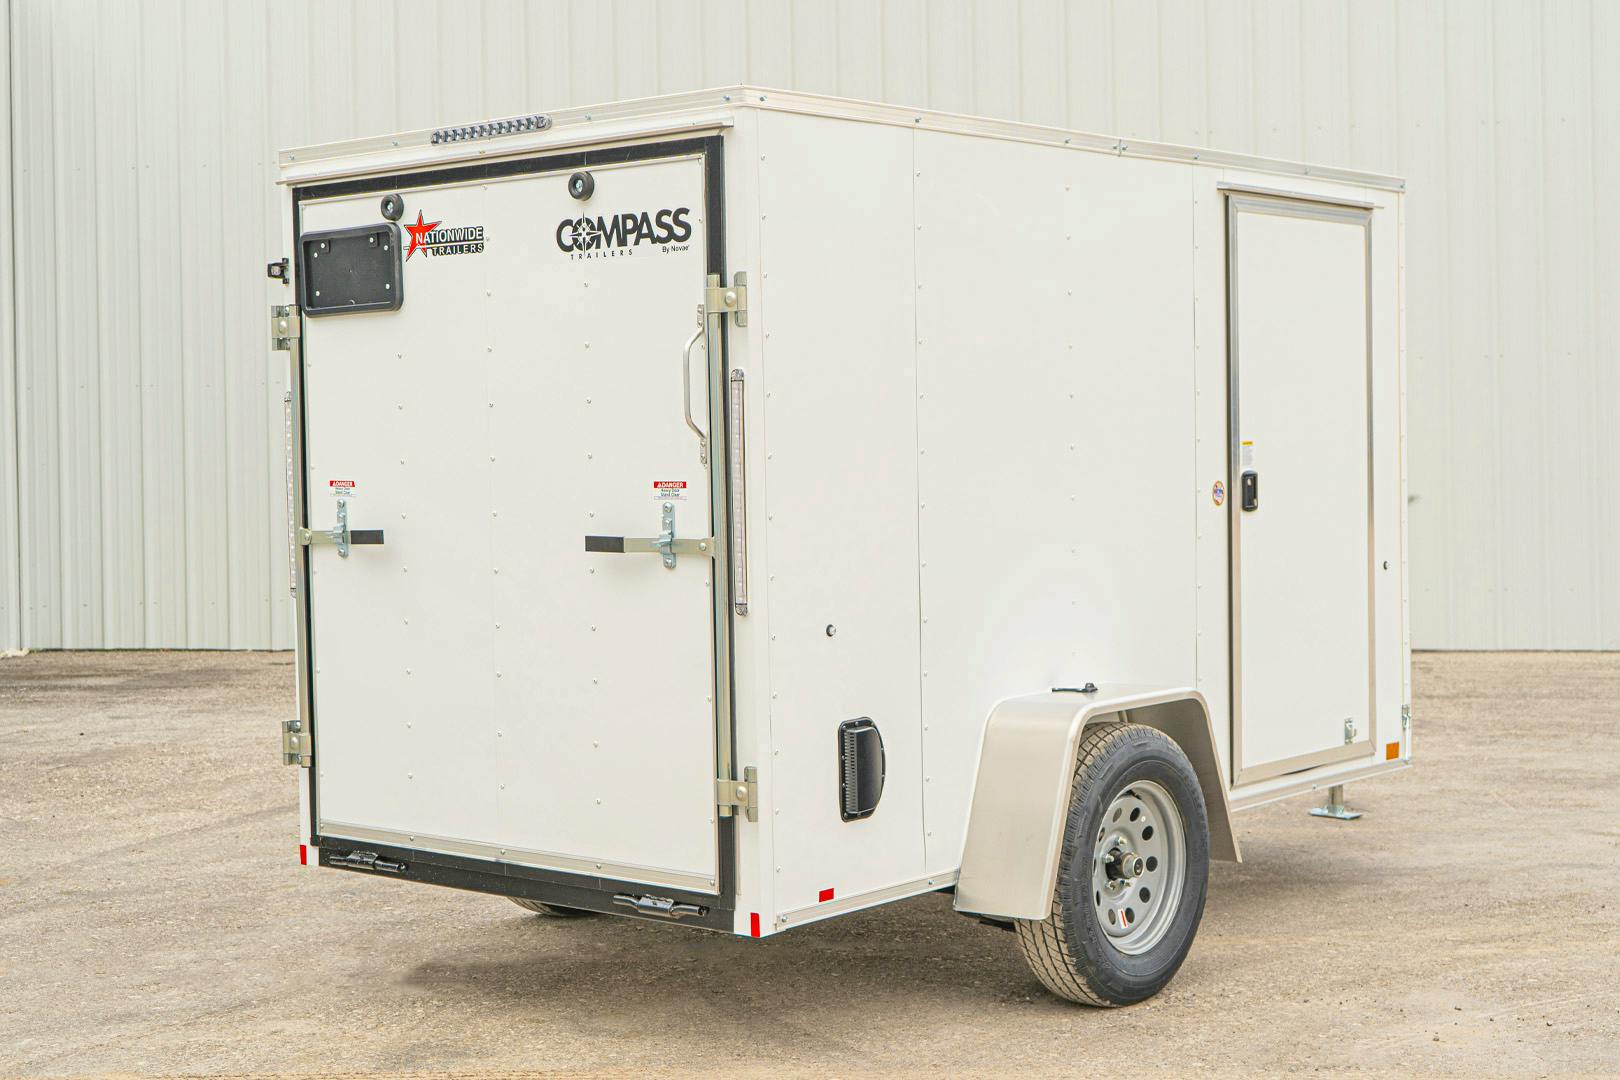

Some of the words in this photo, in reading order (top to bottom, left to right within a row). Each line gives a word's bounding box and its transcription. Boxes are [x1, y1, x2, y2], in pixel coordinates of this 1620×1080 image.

[415, 226, 484, 244] NATIONWIDE
[556, 207, 692, 252] COMPASS
[432, 244, 483, 256] TRAILERS
[571, 249, 633, 260] TRAILERS
[662, 246, 670, 254] By
